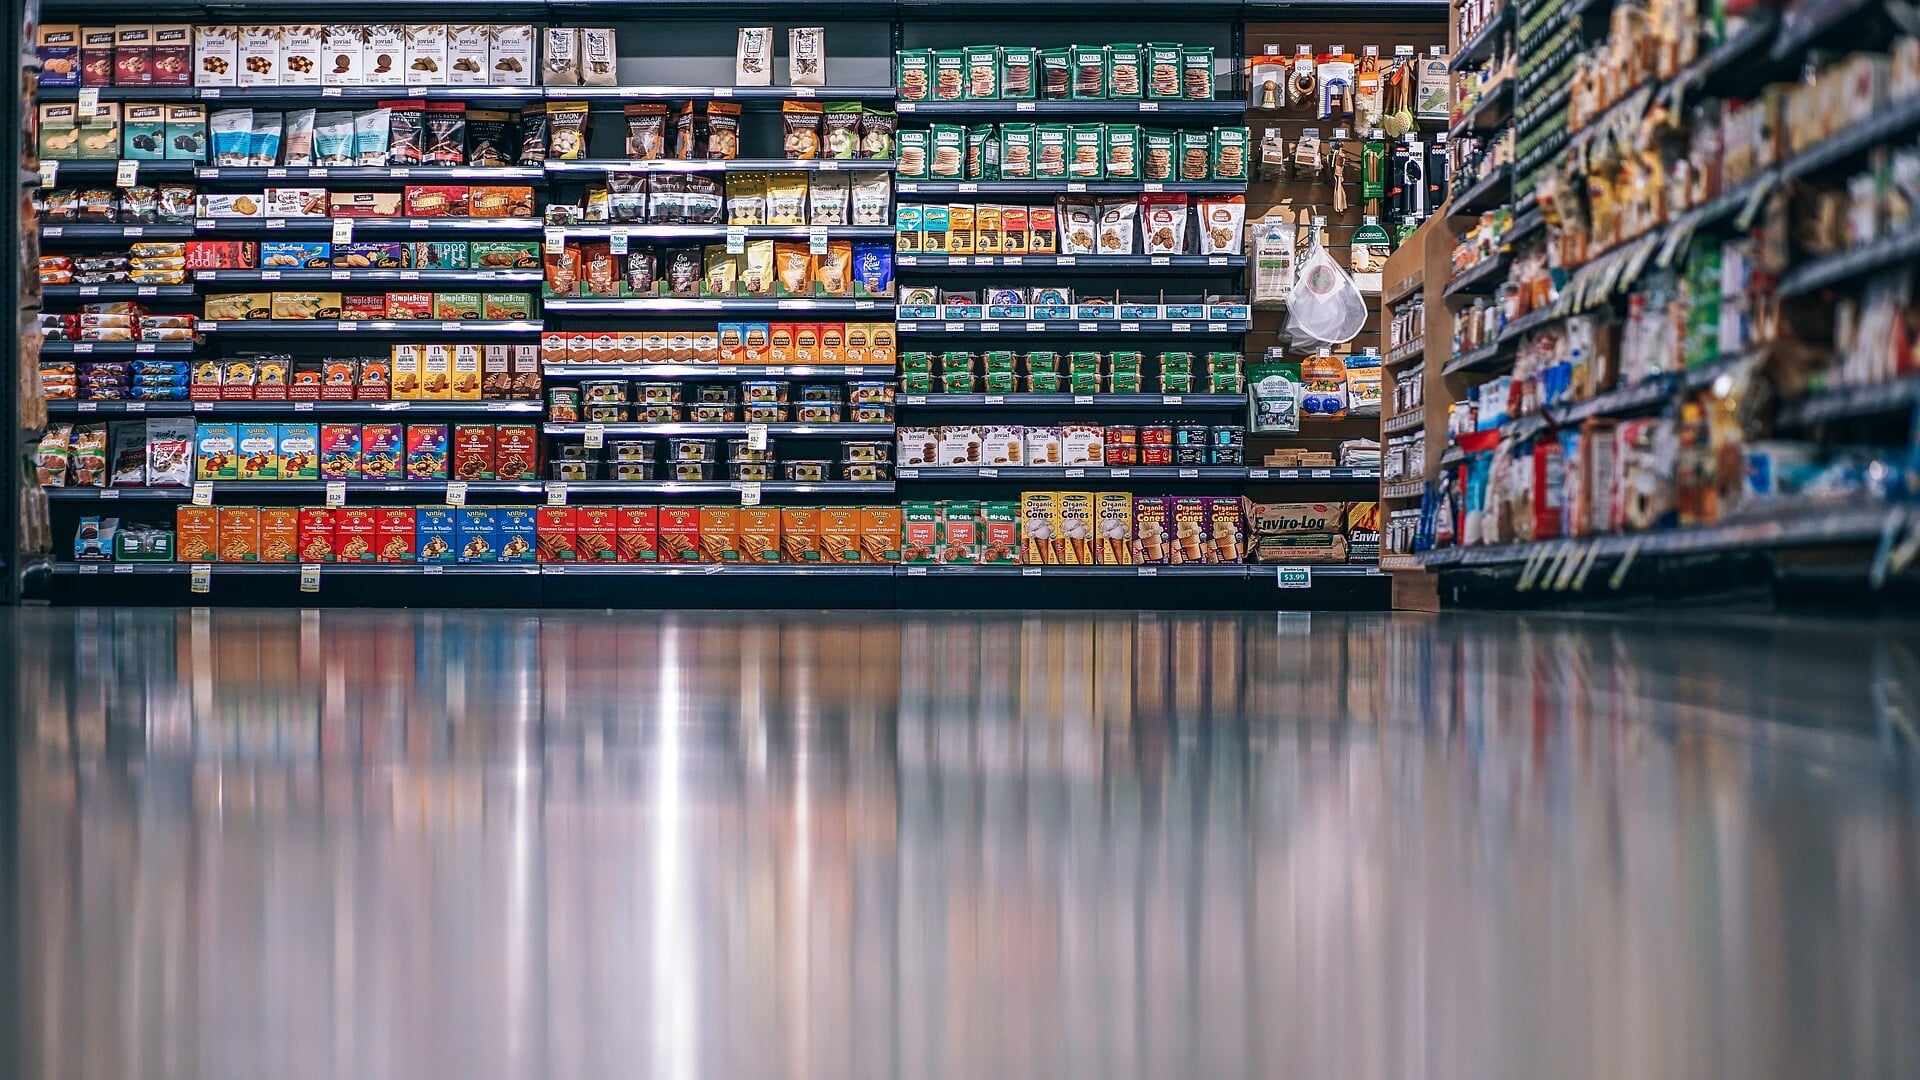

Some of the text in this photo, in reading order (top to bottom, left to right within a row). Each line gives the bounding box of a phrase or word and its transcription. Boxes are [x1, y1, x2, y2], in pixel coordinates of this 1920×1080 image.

[403, 346, 410, 354] n
[433, 346, 440, 354] n
[462, 346, 469, 354] n
[1255, 516, 1326, 530] Enviro-Log
